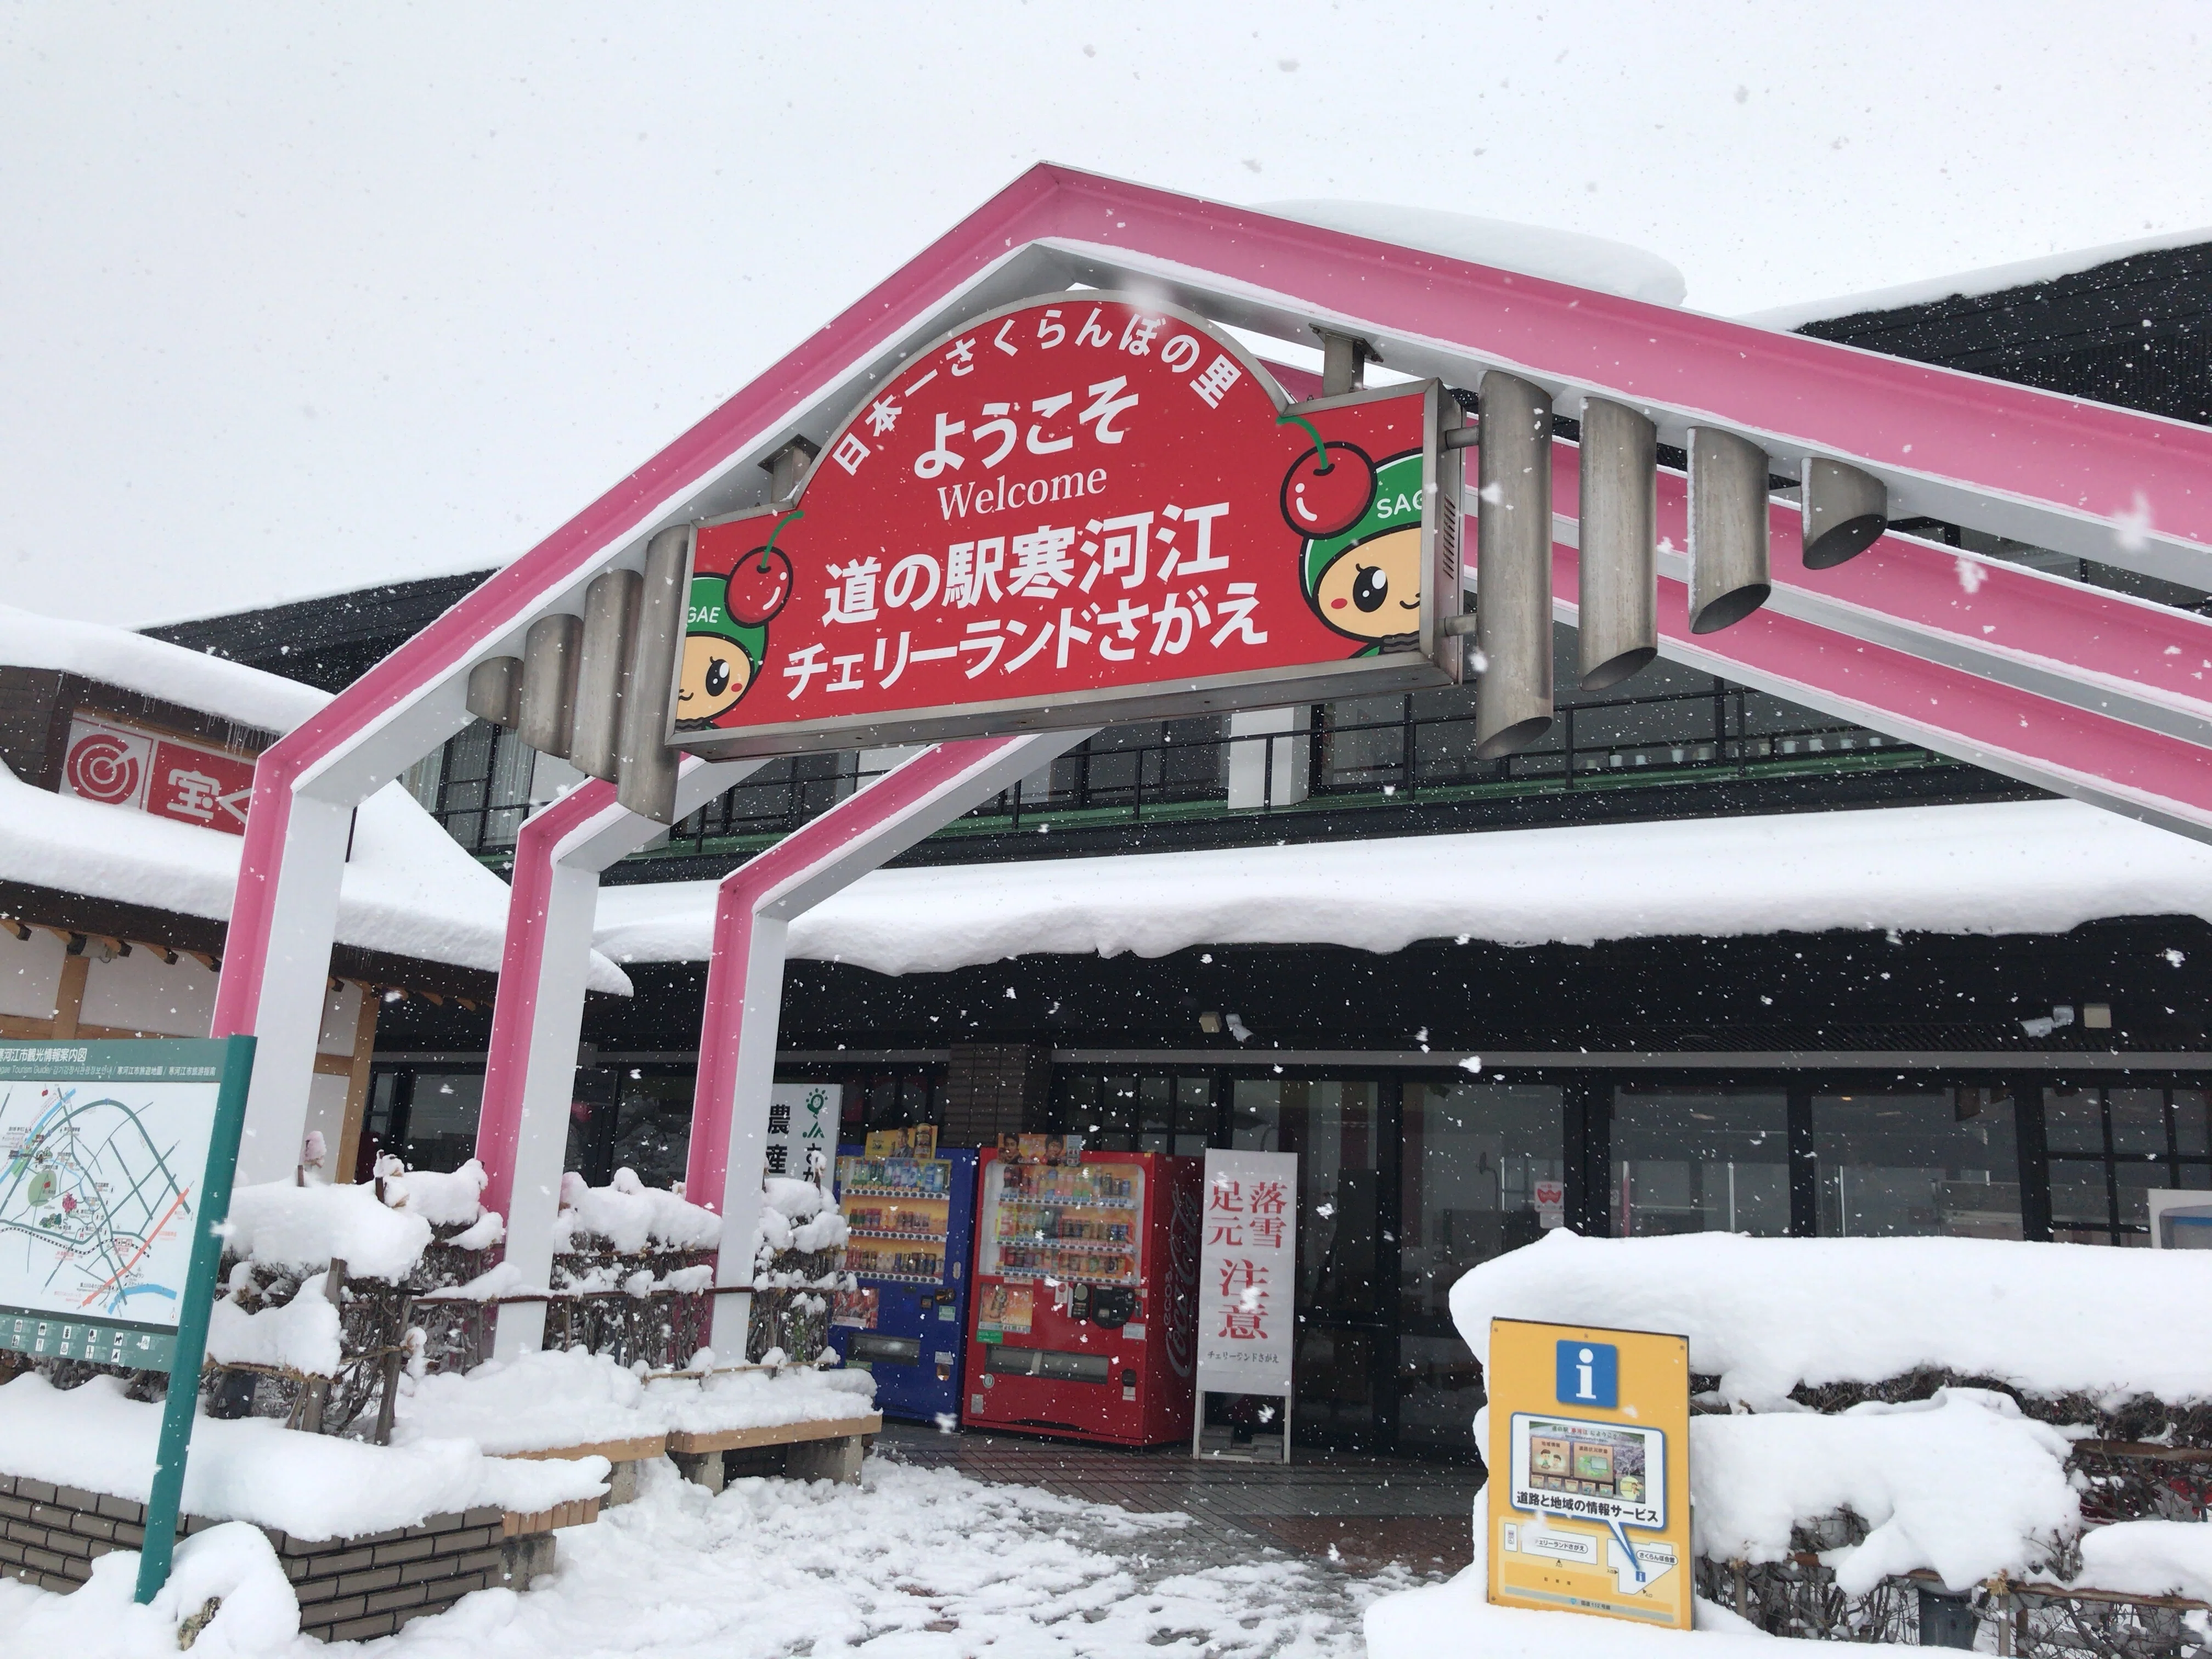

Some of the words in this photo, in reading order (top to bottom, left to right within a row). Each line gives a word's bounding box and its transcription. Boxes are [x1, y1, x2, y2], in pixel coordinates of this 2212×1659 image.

[832, 308, 1242, 476] 日本一さくらんぼの里
[914, 375, 1139, 479] ようこそ
[938, 466, 1107, 521] Welcome
[821, 502, 1229, 628] 道の駅寒河江
[783, 583, 1268, 701] チェリーランドさがえ
[1207, 1180, 1244, 1246] 足元
[1249, 1181, 1288, 1248] 落雪
[1218, 1259, 1269, 1339] 注意
[1517, 1491, 1659, 1523] 道路と地域の情報サービス
[1639, 1552, 1675, 1564] さくらんぼ会館
